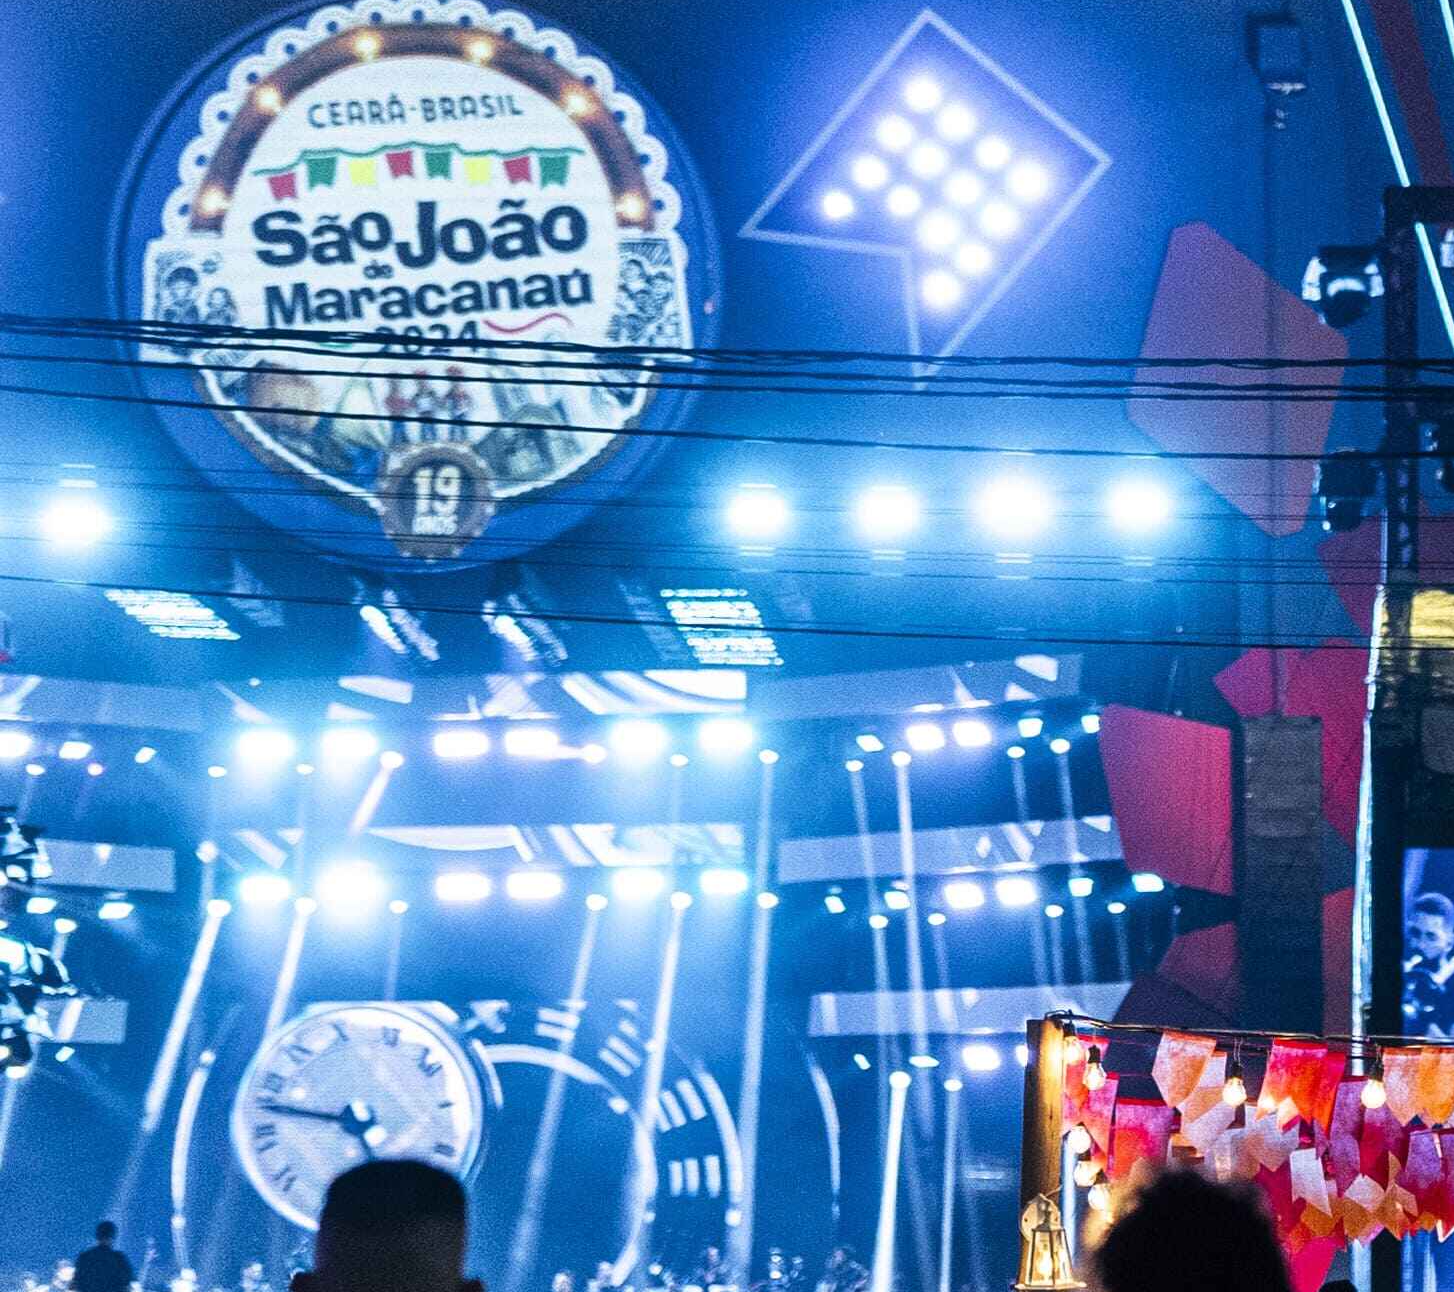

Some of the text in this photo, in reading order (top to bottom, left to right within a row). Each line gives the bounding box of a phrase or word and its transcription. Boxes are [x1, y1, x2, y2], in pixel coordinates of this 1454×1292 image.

[252, 198, 588, 269] São João
[264, 268, 594, 326] Maracanaú
[363, 261, 394, 279] de
[413, 465, 461, 516] 19
